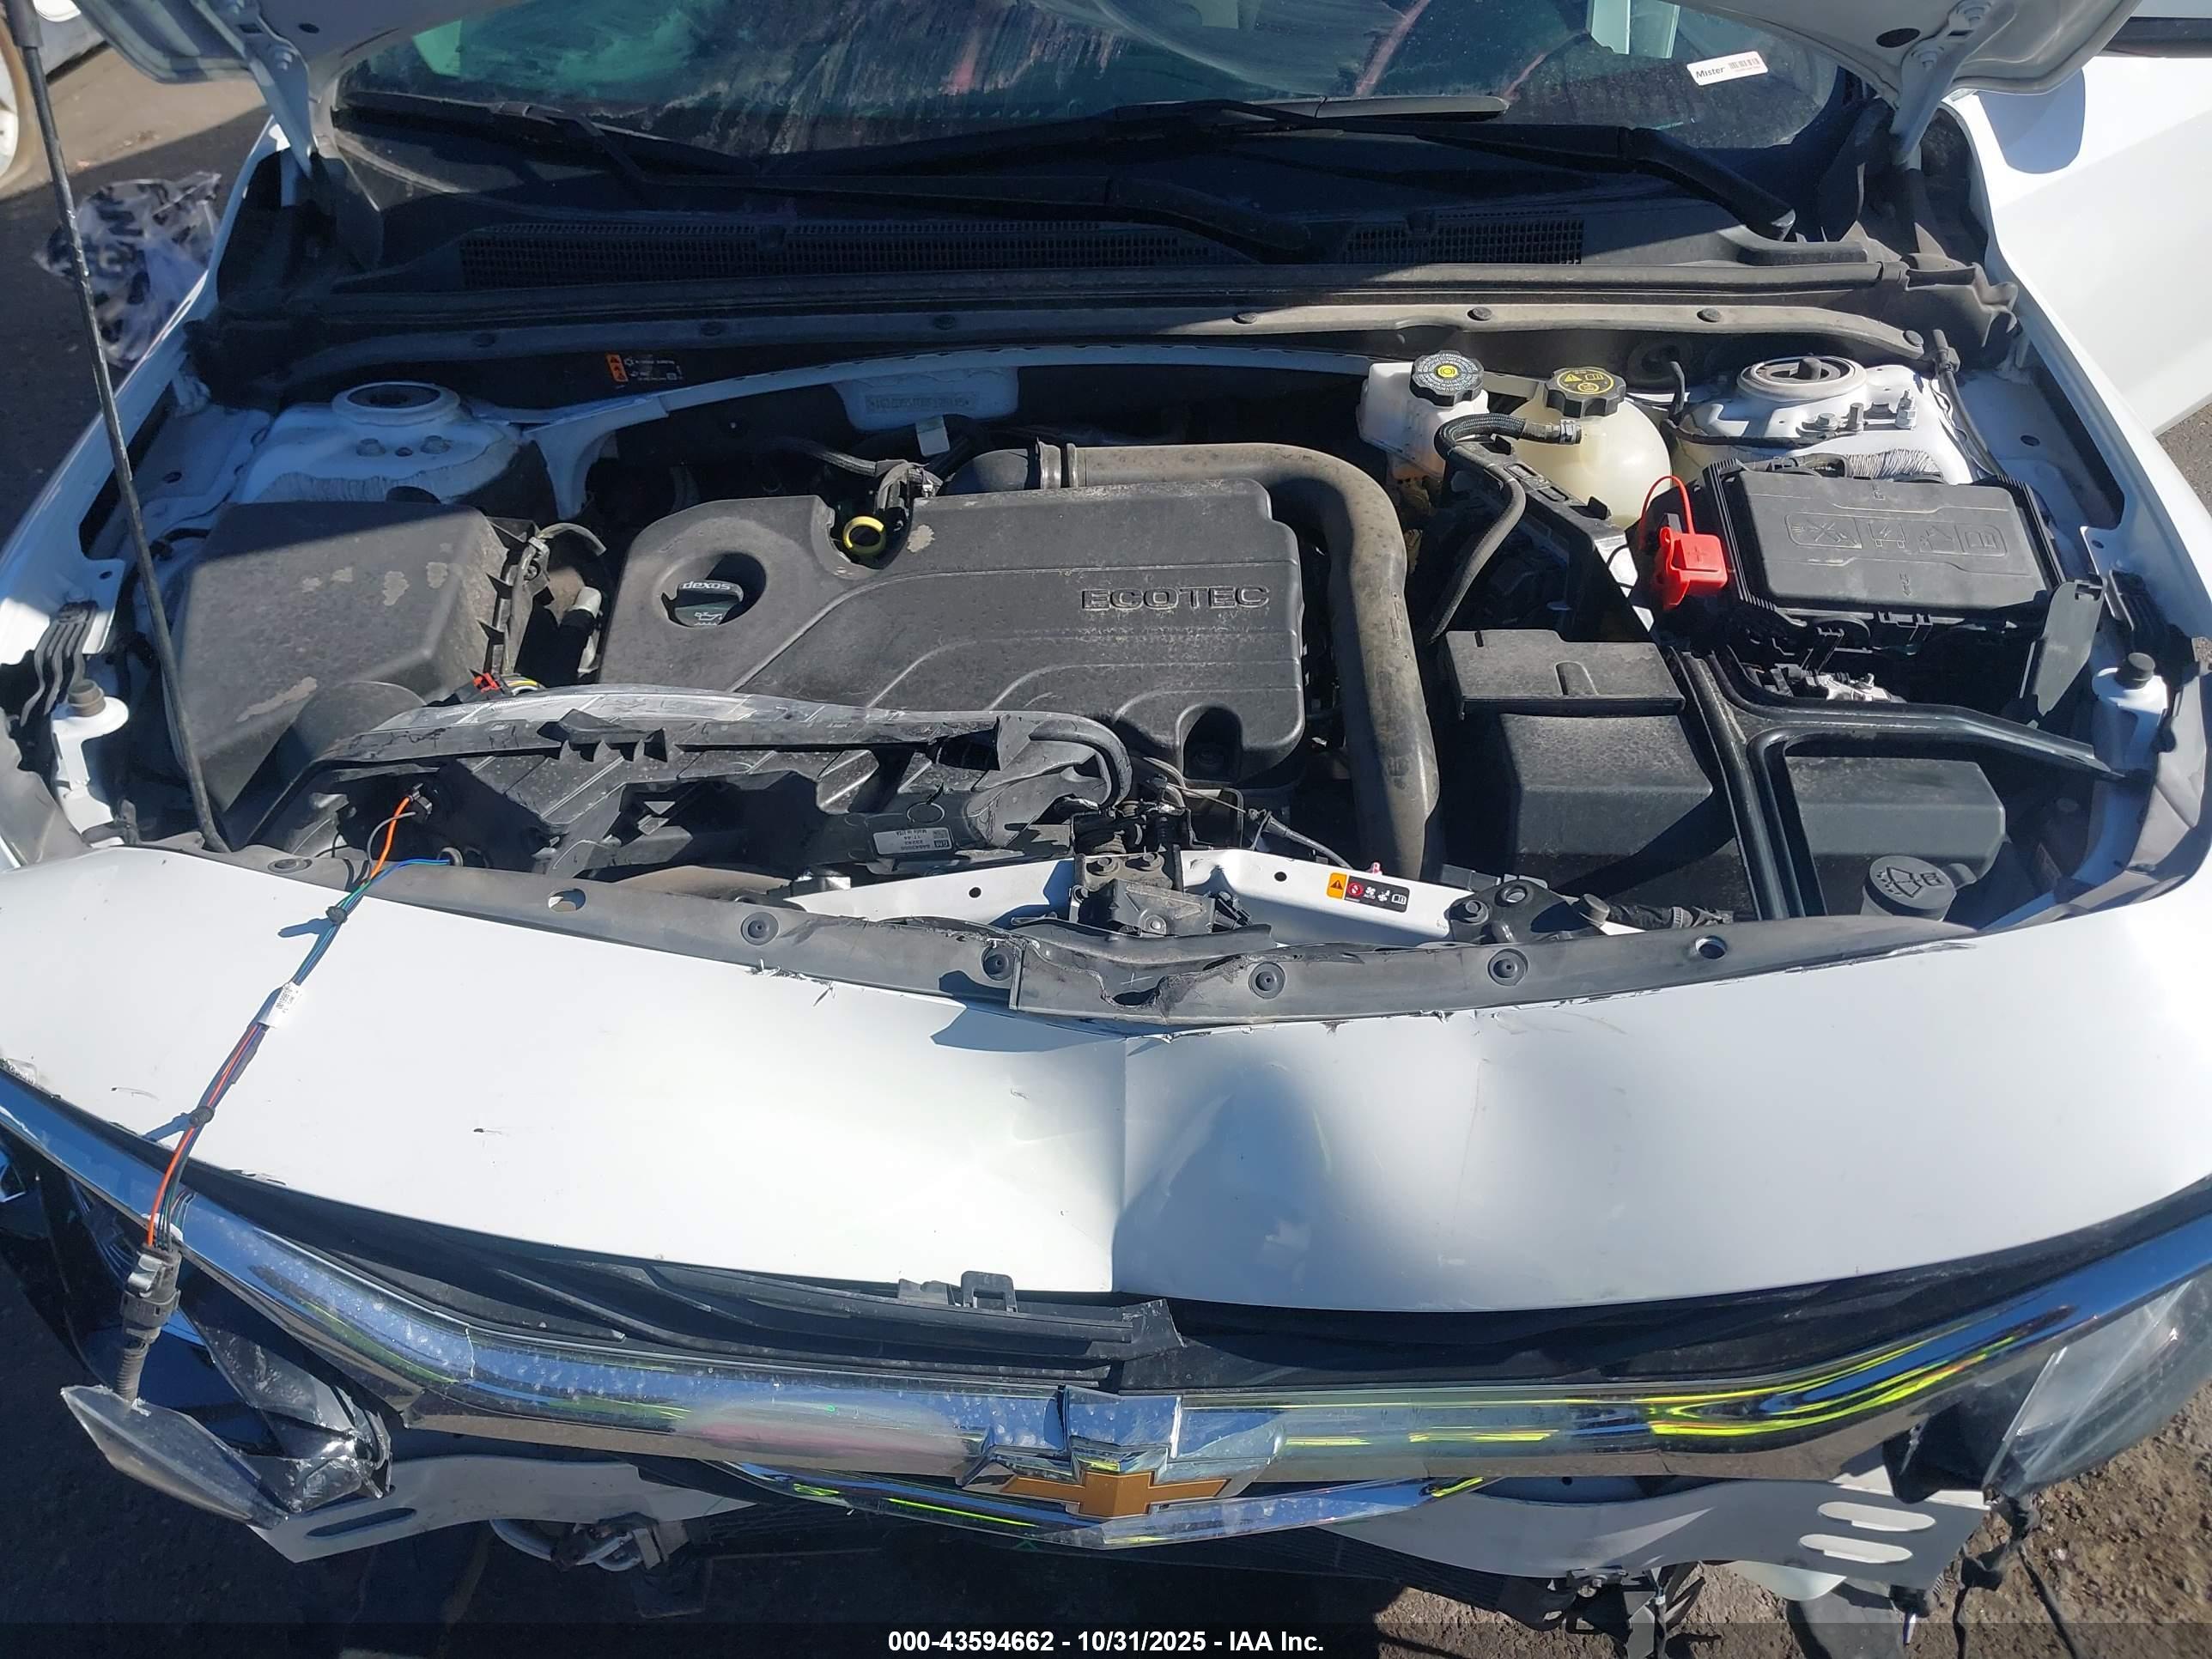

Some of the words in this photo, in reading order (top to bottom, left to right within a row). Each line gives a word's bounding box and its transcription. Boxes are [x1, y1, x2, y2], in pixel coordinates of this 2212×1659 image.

[1695, 67, 1725, 78] Mister
[682, 580, 731, 591] dexos
[1081, 585, 1269, 611] ECOTEC
